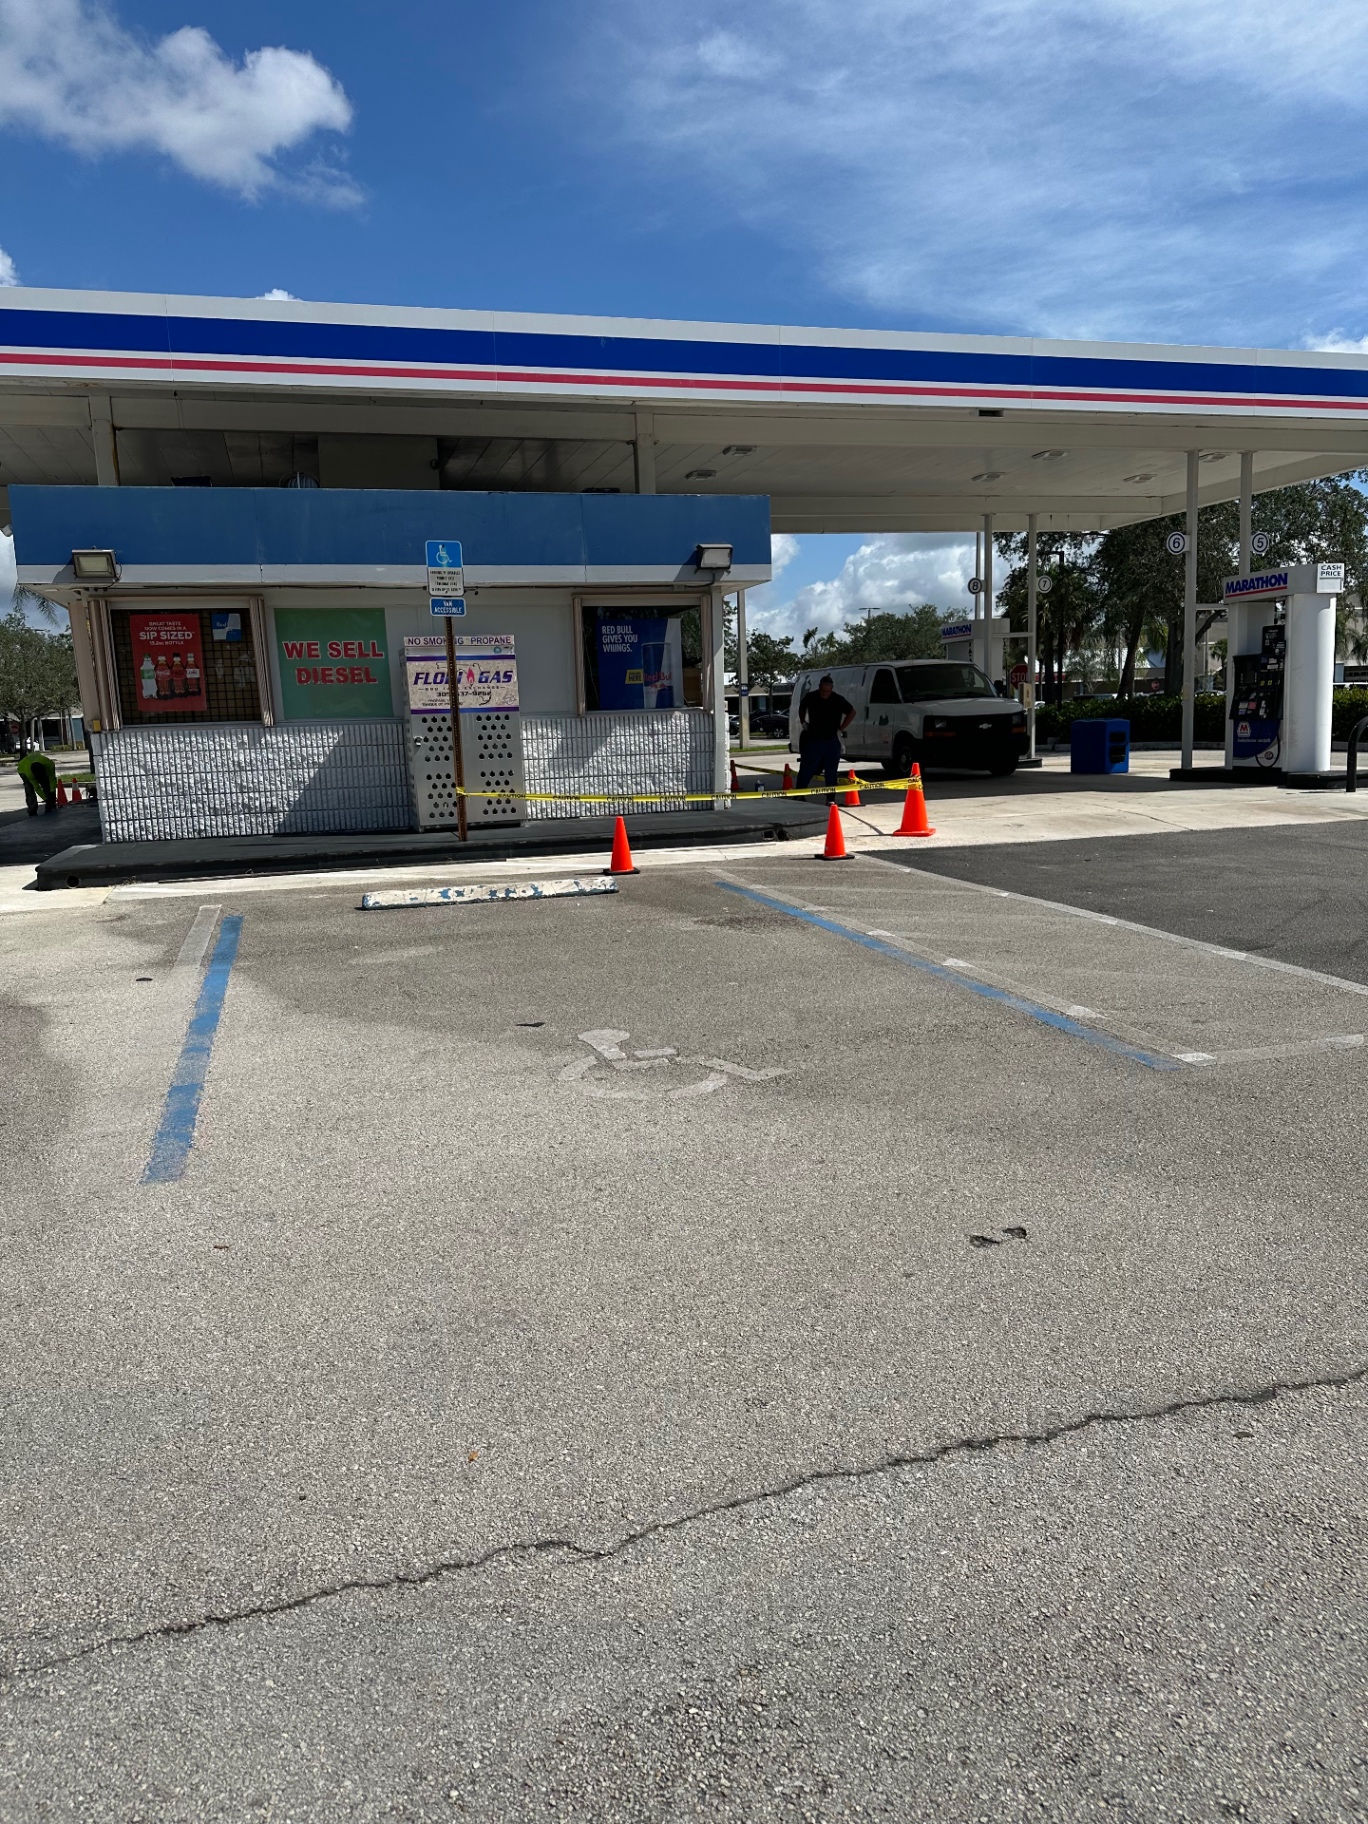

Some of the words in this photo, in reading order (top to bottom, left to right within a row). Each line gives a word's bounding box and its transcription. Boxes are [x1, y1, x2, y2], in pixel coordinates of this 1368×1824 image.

[1172, 538, 1181, 549] 6
[1256, 537, 1264, 547] 5
[972, 581, 978, 590] 8
[1042, 580, 1048, 588] 7
[1225, 572, 1288, 594] MARATHON
[602, 625, 616, 634] RED
[616, 625, 633, 634] BULL
[942, 624, 972, 636] MARATHON
[139, 631, 158, 640] SIP
[602, 635, 622, 643] GIVES
[623, 634, 638, 643] YOU
[408, 638, 421, 646] NO
[470, 636, 511, 645] PROPANE
[282, 641, 321, 660] WE
[327, 640, 385, 659] SELL
[295, 666, 379, 685] DIESEL
[478, 670, 514, 684] GAS
